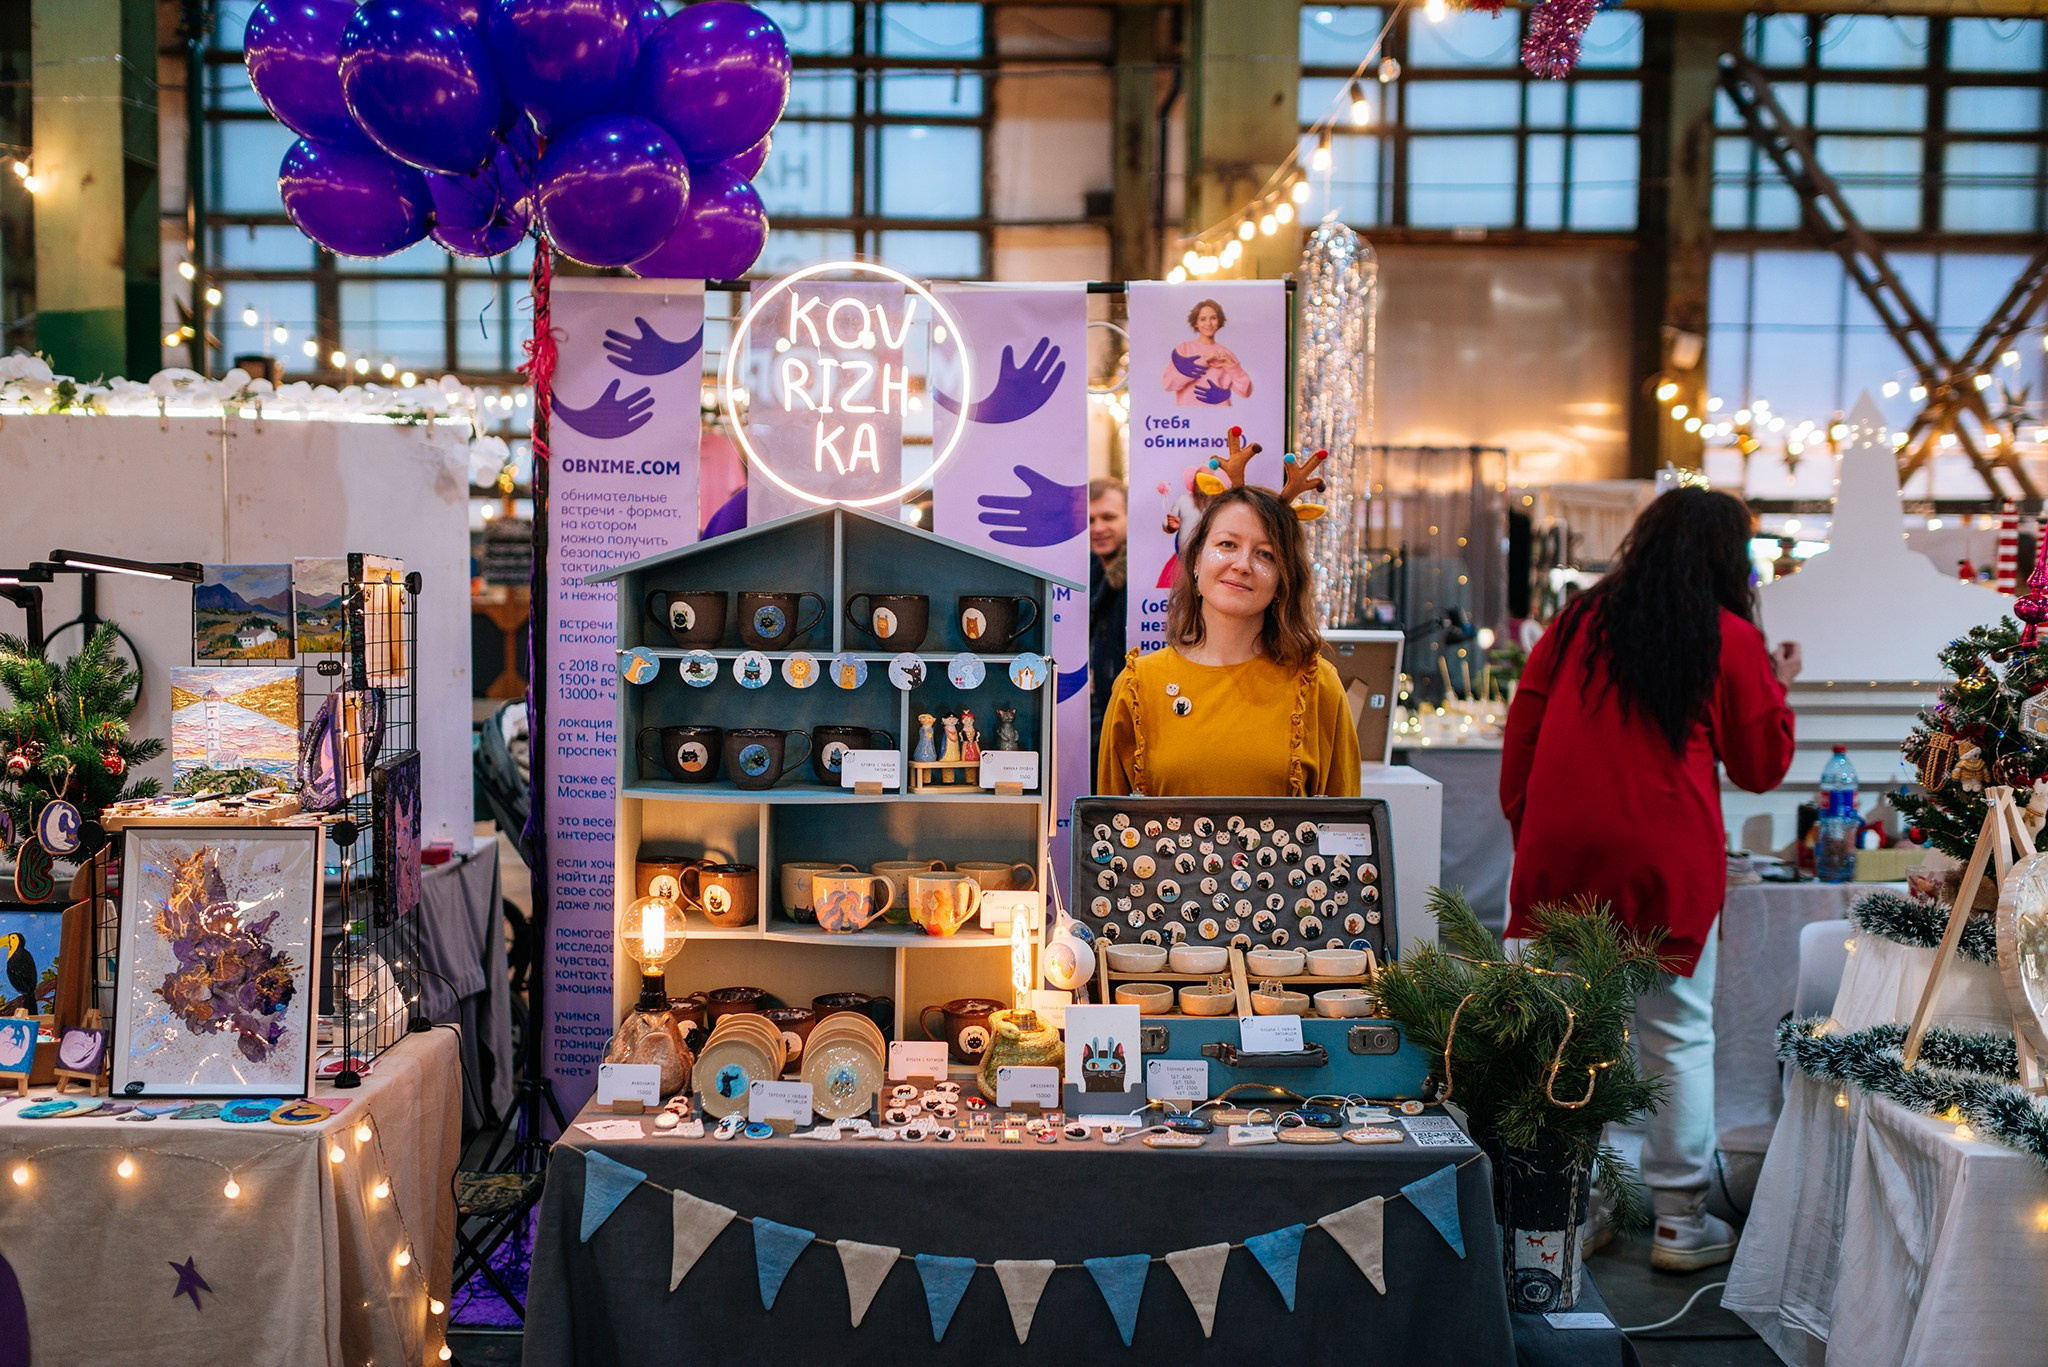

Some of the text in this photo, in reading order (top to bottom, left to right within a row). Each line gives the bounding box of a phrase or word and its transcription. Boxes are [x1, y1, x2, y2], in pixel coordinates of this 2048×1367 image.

[789, 292, 918, 350] KOV
[782, 357, 909, 417] RIZH
[1144, 414, 1190, 431] (тебя
[815, 420, 881, 476] KA
[561, 458, 681, 475] OBNIME.COM
[561, 488, 668, 503] обнимательные
[561, 505, 615, 518] встречи
[626, 506, 682, 520] формат,
[561, 520, 637, 533] на котором
[561, 534, 669, 548] можно получить
[560, 545, 641, 561] безопасную
[560, 562, 618, 573] тактиль
[559, 591, 568, 601] и
[559, 619, 613, 633] встречи
[318, 663, 338, 671] 2500
[558, 659, 617, 674] с 2018 го
[558, 673, 617, 687] 1500+ вс
[558, 687, 604, 700] 13000+
[558, 718, 613, 729] локация
[557, 731, 573, 742] от
[576, 733, 589, 742] м.
[558, 774, 598, 785] также
[557, 786, 607, 799] Москве
[557, 816, 616, 827] это весе
[556, 857, 615, 869] если хоч
[556, 871, 596, 883] найти
[556, 886, 615, 897] свое соо
[555, 900, 614, 911] даже лю
[555, 956, 610, 968] чувства,
[555, 970, 608, 981] контакт
[554, 1011, 600, 1022] учимся
[554, 1067, 592, 1077] «нет»
